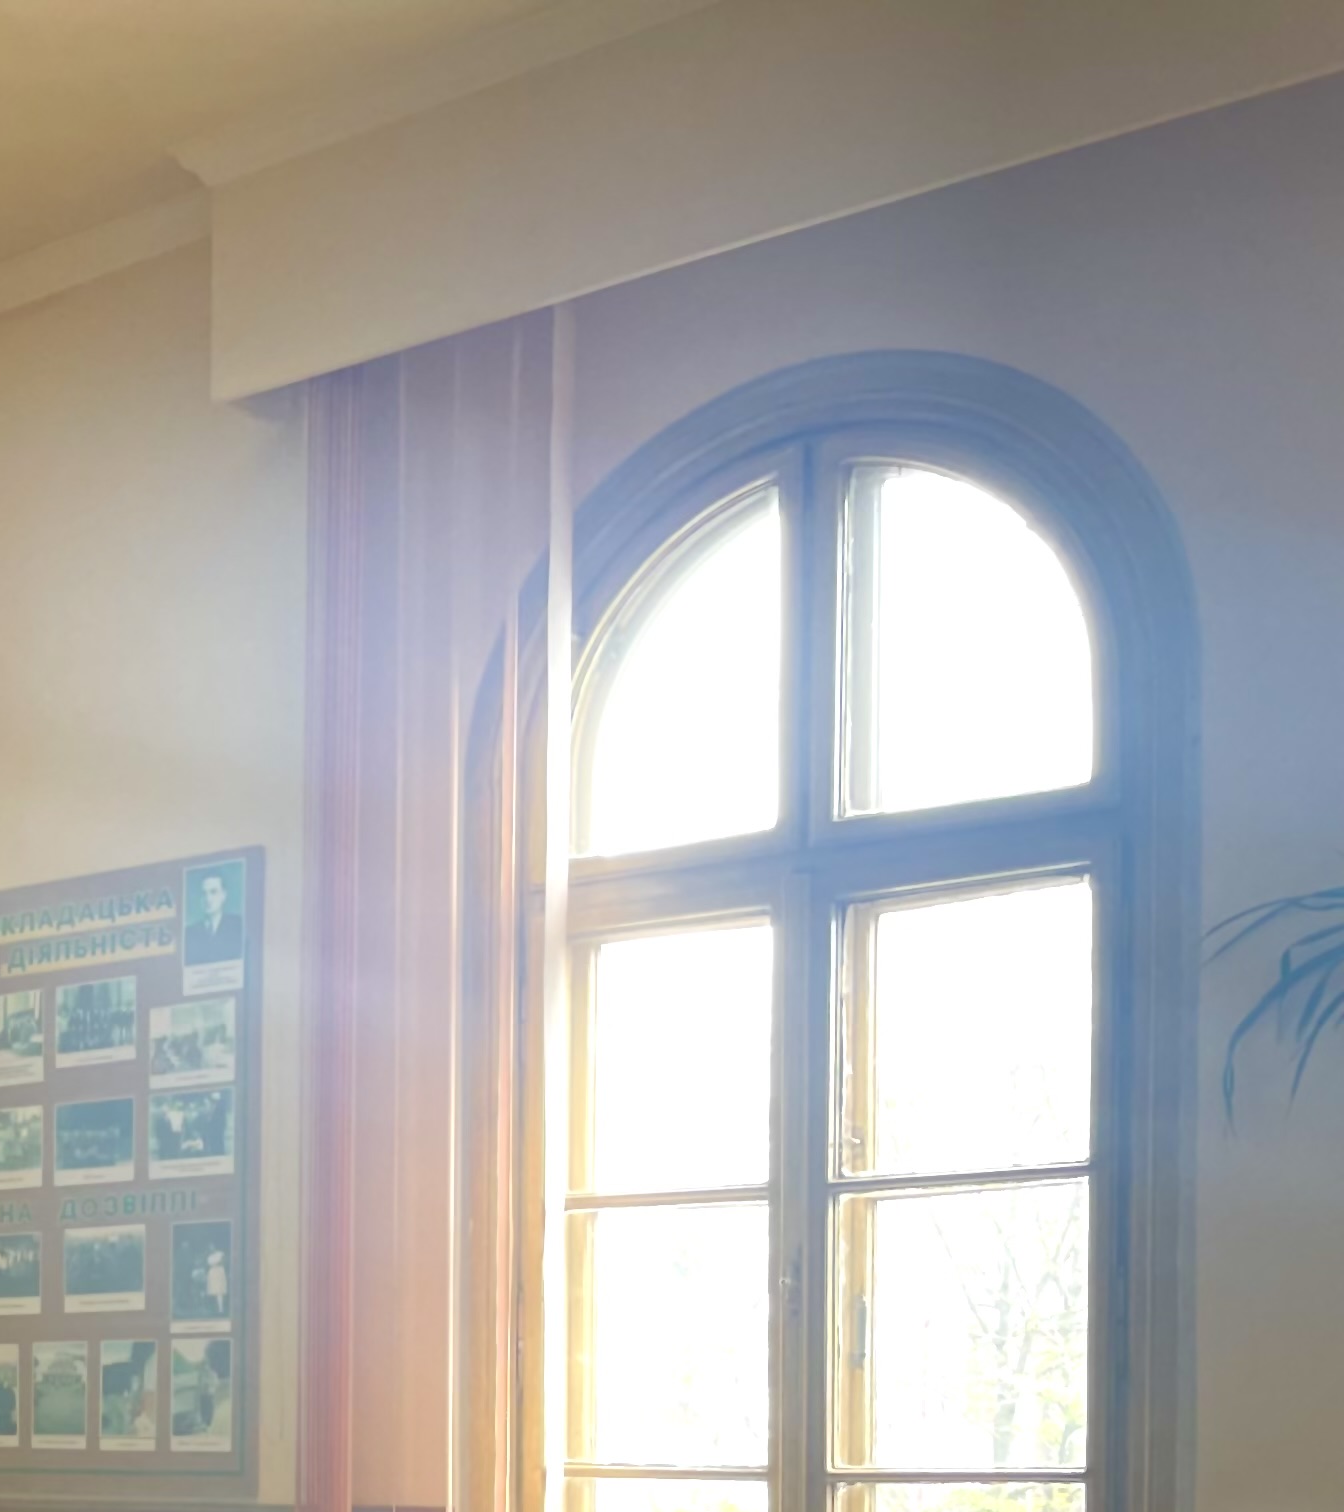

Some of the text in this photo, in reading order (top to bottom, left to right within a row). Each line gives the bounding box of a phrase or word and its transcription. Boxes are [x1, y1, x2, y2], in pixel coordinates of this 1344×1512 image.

[7, 927, 173, 973] ДІЯЛЬНІСТЬ
[0, 1191, 196, 1223] НА ДОЗВІЛЛІ
